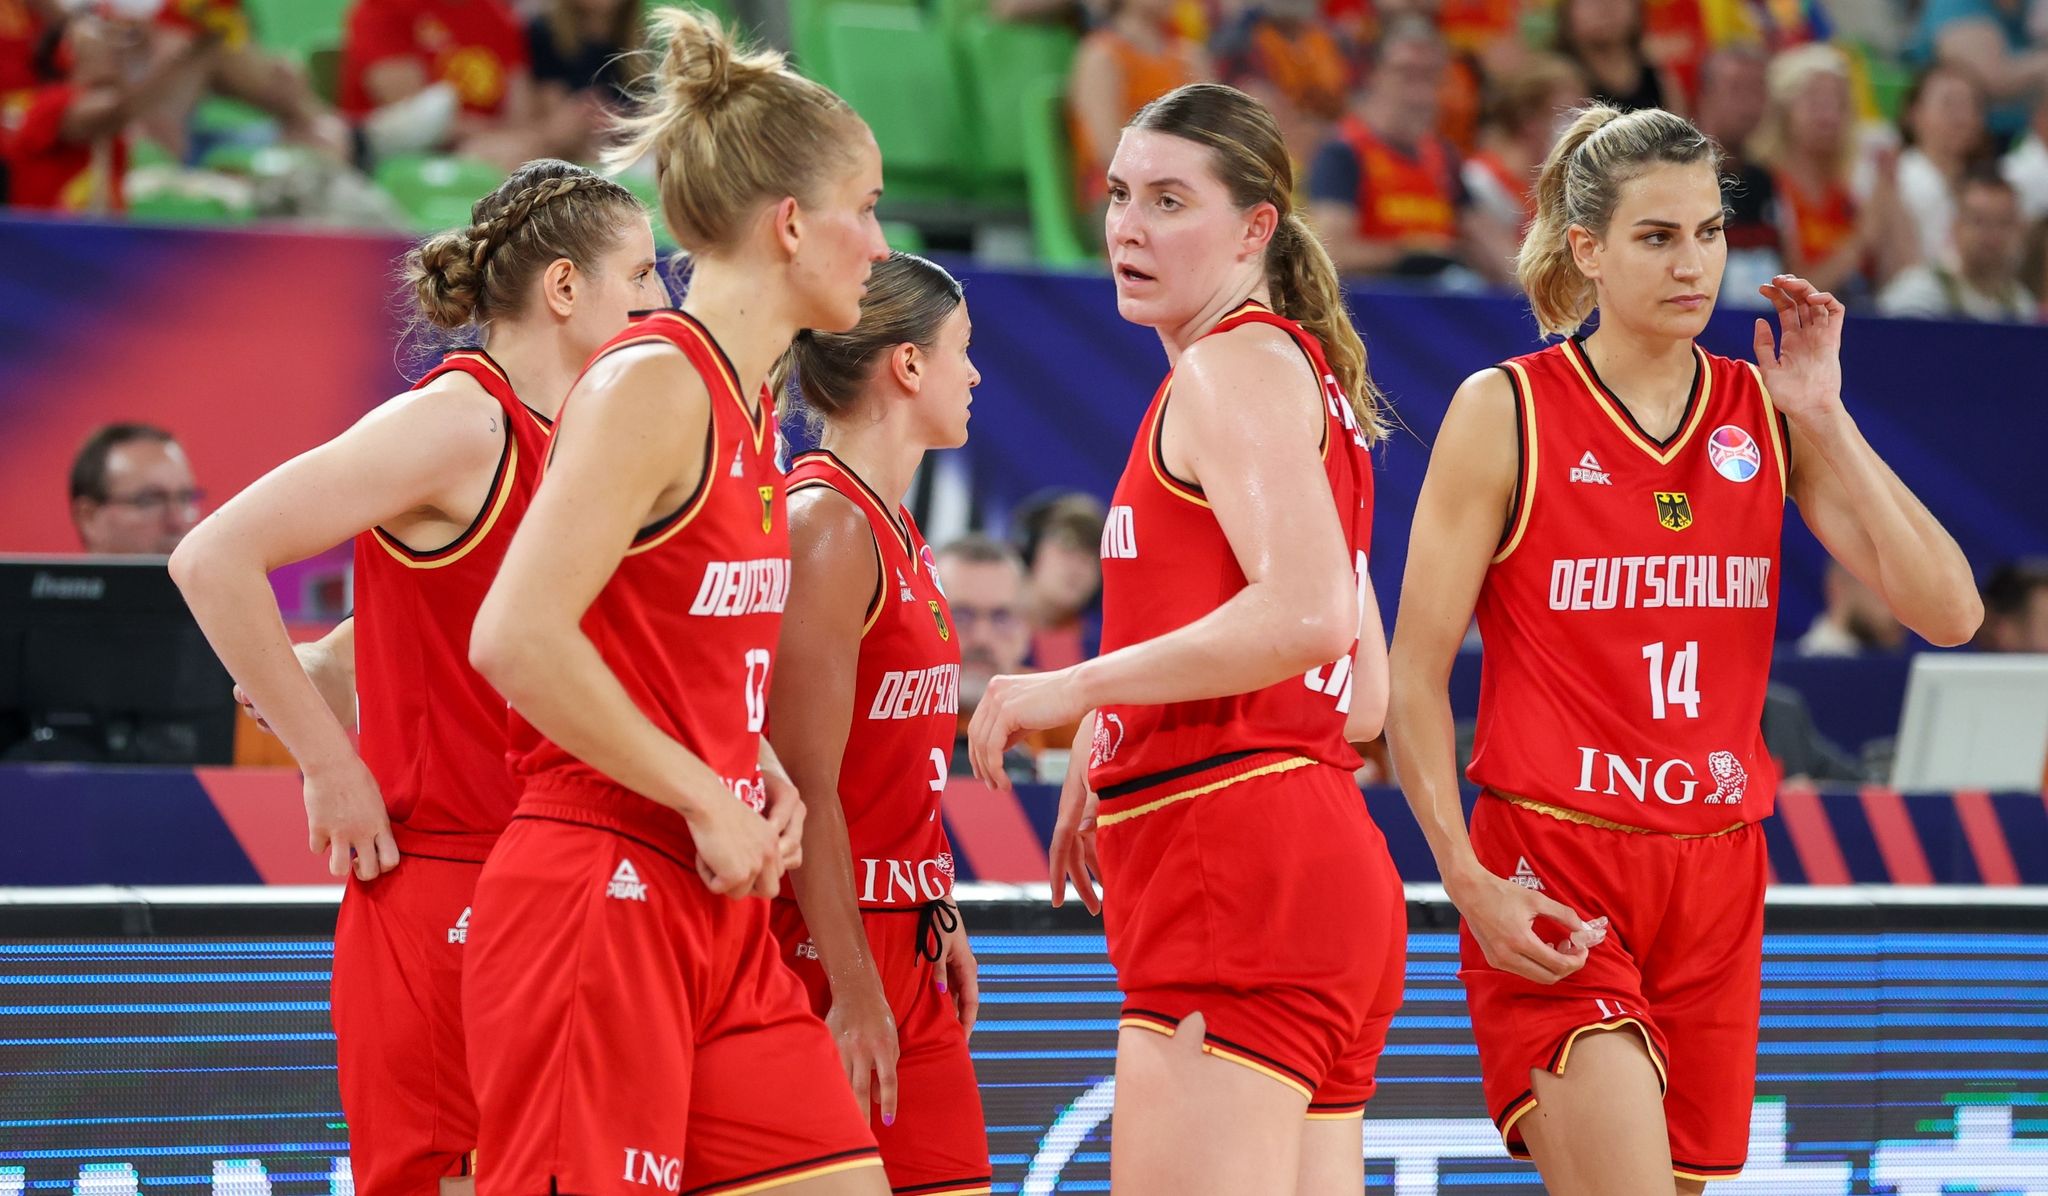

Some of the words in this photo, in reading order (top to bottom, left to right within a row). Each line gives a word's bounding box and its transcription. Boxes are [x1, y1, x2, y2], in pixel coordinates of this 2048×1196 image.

[1570, 467, 1612, 485] PEAK
[1549, 555, 1771, 611] DEUTSCHLAND
[1642, 641, 1700, 719] 14
[1574, 746, 1699, 805] ING
[859, 858, 945, 903] ING
[622, 1146, 680, 1193] ING
